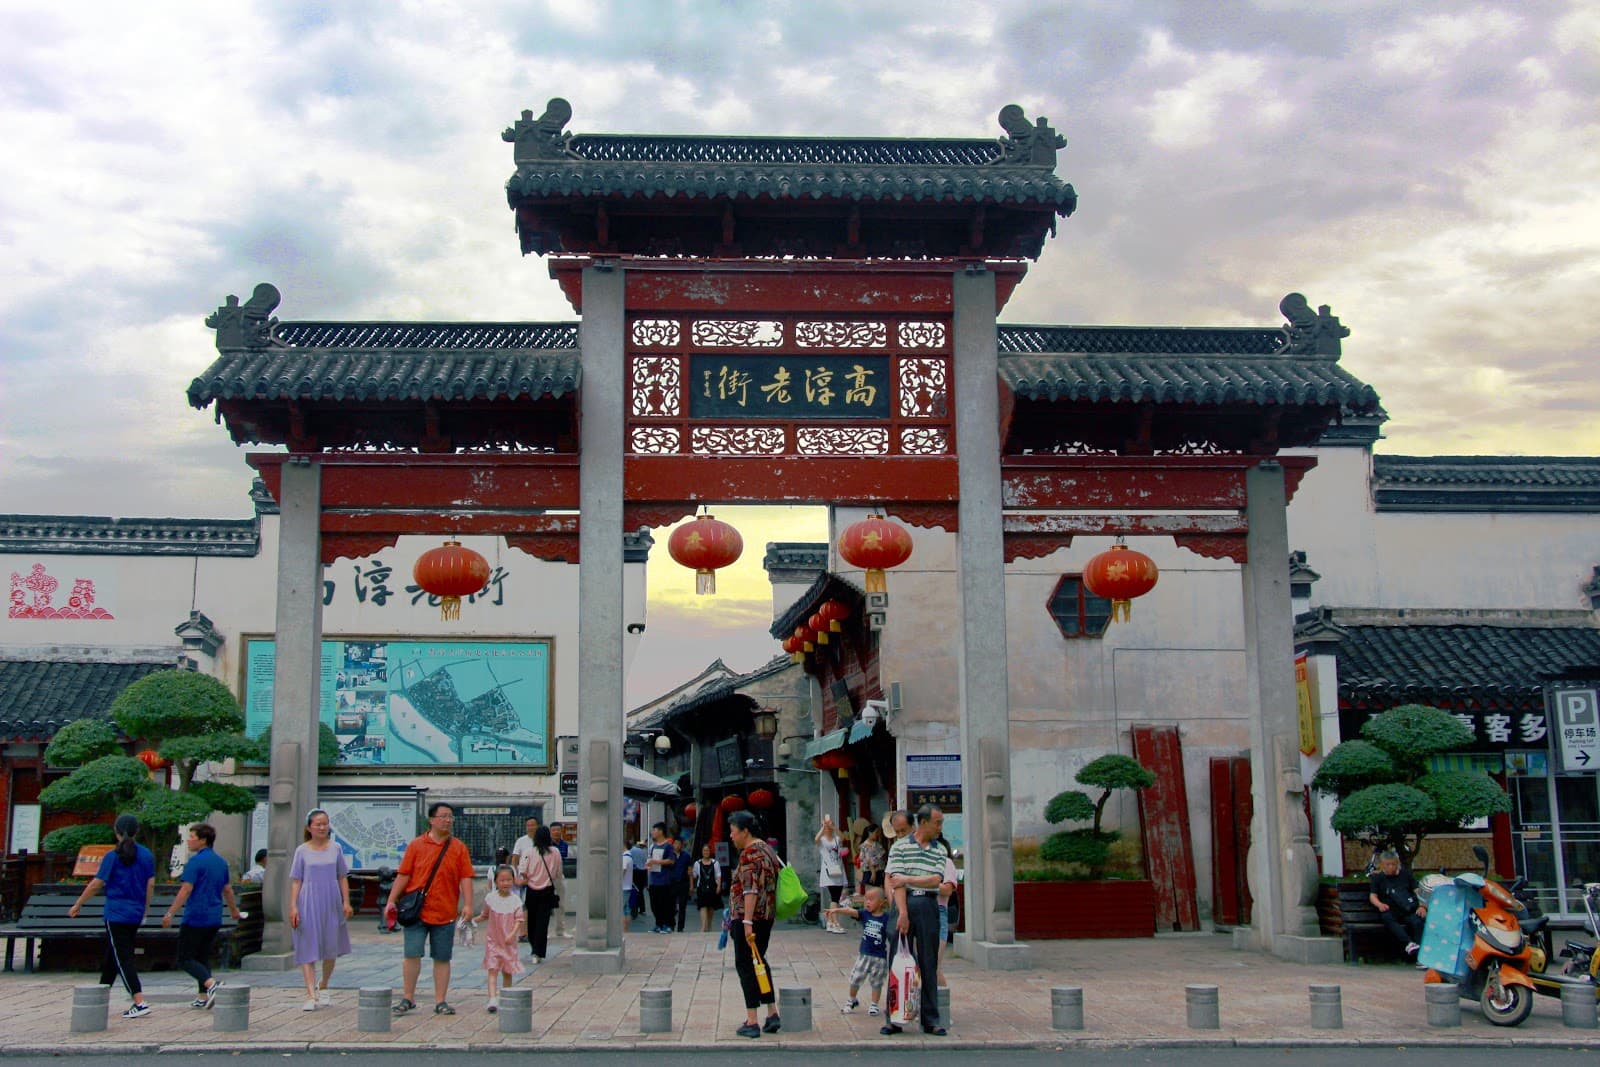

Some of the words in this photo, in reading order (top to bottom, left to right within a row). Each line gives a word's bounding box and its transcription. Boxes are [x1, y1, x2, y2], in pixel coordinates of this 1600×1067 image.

[718, 364, 877, 407] 高淳老街
[1567, 696, 1587, 722] P
[1564, 727, 1596, 739] 停车场
